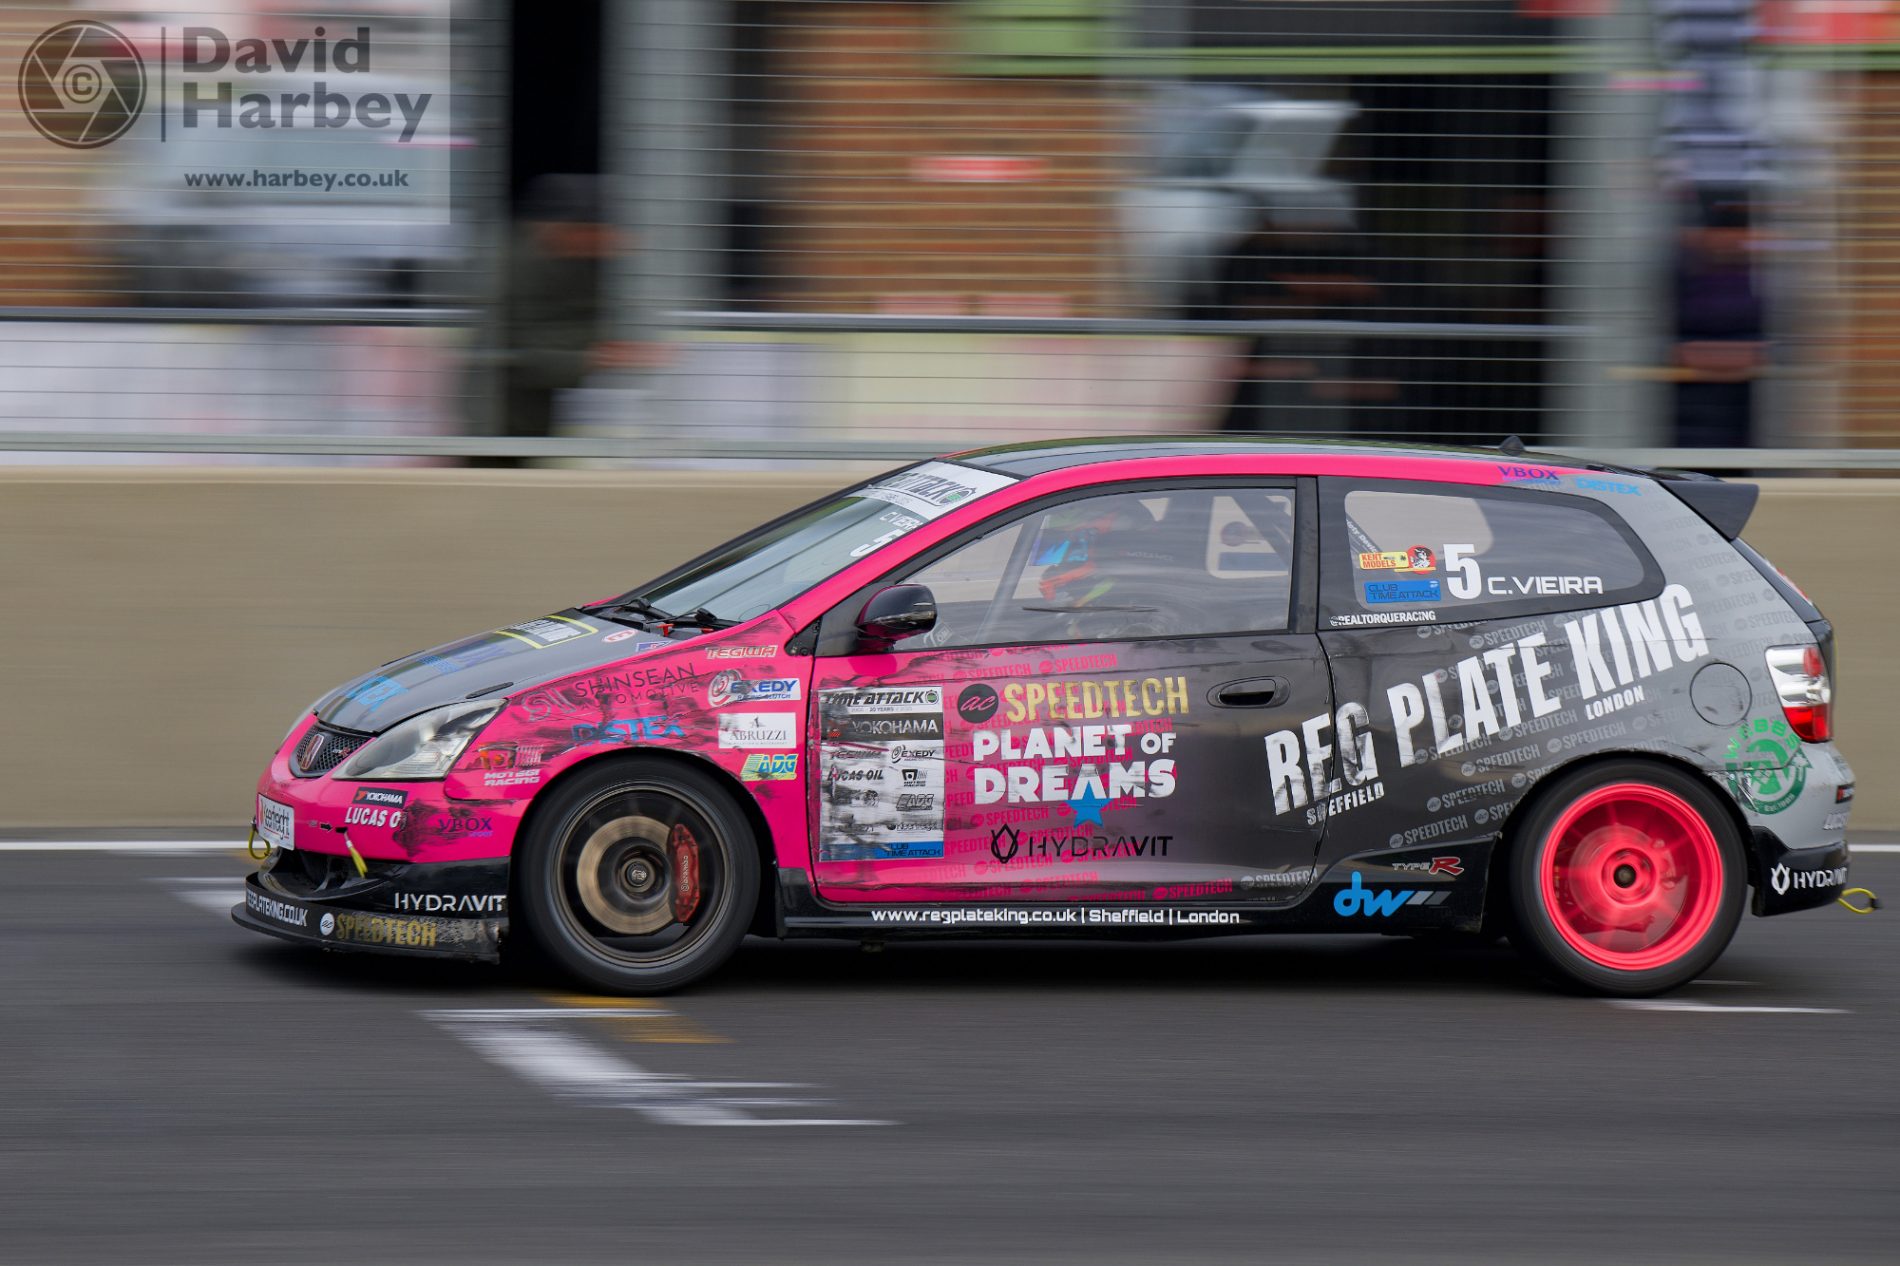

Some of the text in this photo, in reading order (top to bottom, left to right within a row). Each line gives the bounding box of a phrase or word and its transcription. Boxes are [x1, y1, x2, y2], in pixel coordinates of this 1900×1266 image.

[1498, 466, 1560, 480] VBOX
[1361, 553, 1383, 561] KENT
[1362, 560, 1397, 569] MODELS
[1443, 543, 1603, 600] 5 C.VIEIRA
[1368, 584, 1398, 593] CLUB
[1371, 590, 1440, 600] TIME ATTACK
[1484, 620, 1548, 646] SPEEDTECH
[706, 644, 778, 659] TEGIWA
[1055, 654, 1117, 673] SPEEDTECH
[575, 662, 700, 698] SHINSEAN
[1004, 676, 1189, 723] SPEEDTECH
[1264, 583, 1710, 817] REG PLATE KING
[1585, 686, 1646, 721] LONDON
[852, 719, 939, 735] YOKOHAMA
[1515, 709, 1578, 737] SPEEDTECH
[729, 730, 787, 741] ABRUZZI
[973, 724, 1133, 761] PLANET
[1140, 733, 1177, 755] OF
[1562, 722, 1626, 749] SPEEDTECH
[758, 755, 798, 773] ADG
[901, 749, 936, 758] EXEDY
[1476, 744, 1541, 773] SPEEDTECH
[484, 777, 540, 786] RACING
[865, 769, 884, 780] OIL
[974, 759, 1177, 805] DREAMS
[366, 791, 403, 805] YOKOHAMA
[1306, 782, 1385, 826] SHEFFIELD
[345, 806, 386, 827] LUCAS
[987, 808, 1049, 826] SPEEDTECH
[1405, 815, 1469, 844] SPEEDTECH
[1029, 836, 1173, 857] HYDRAVIT
[1391, 856, 1465, 876] TYPE R
[1169, 878, 1232, 900] SPEEDTECH
[1333, 871, 1415, 917] dw
[395, 891, 507, 912] HYDRAVIT
[871, 906, 1241, 926] www.regplateking.co.uk Sheffield London
[336, 914, 438, 947] SPEEDTECH
